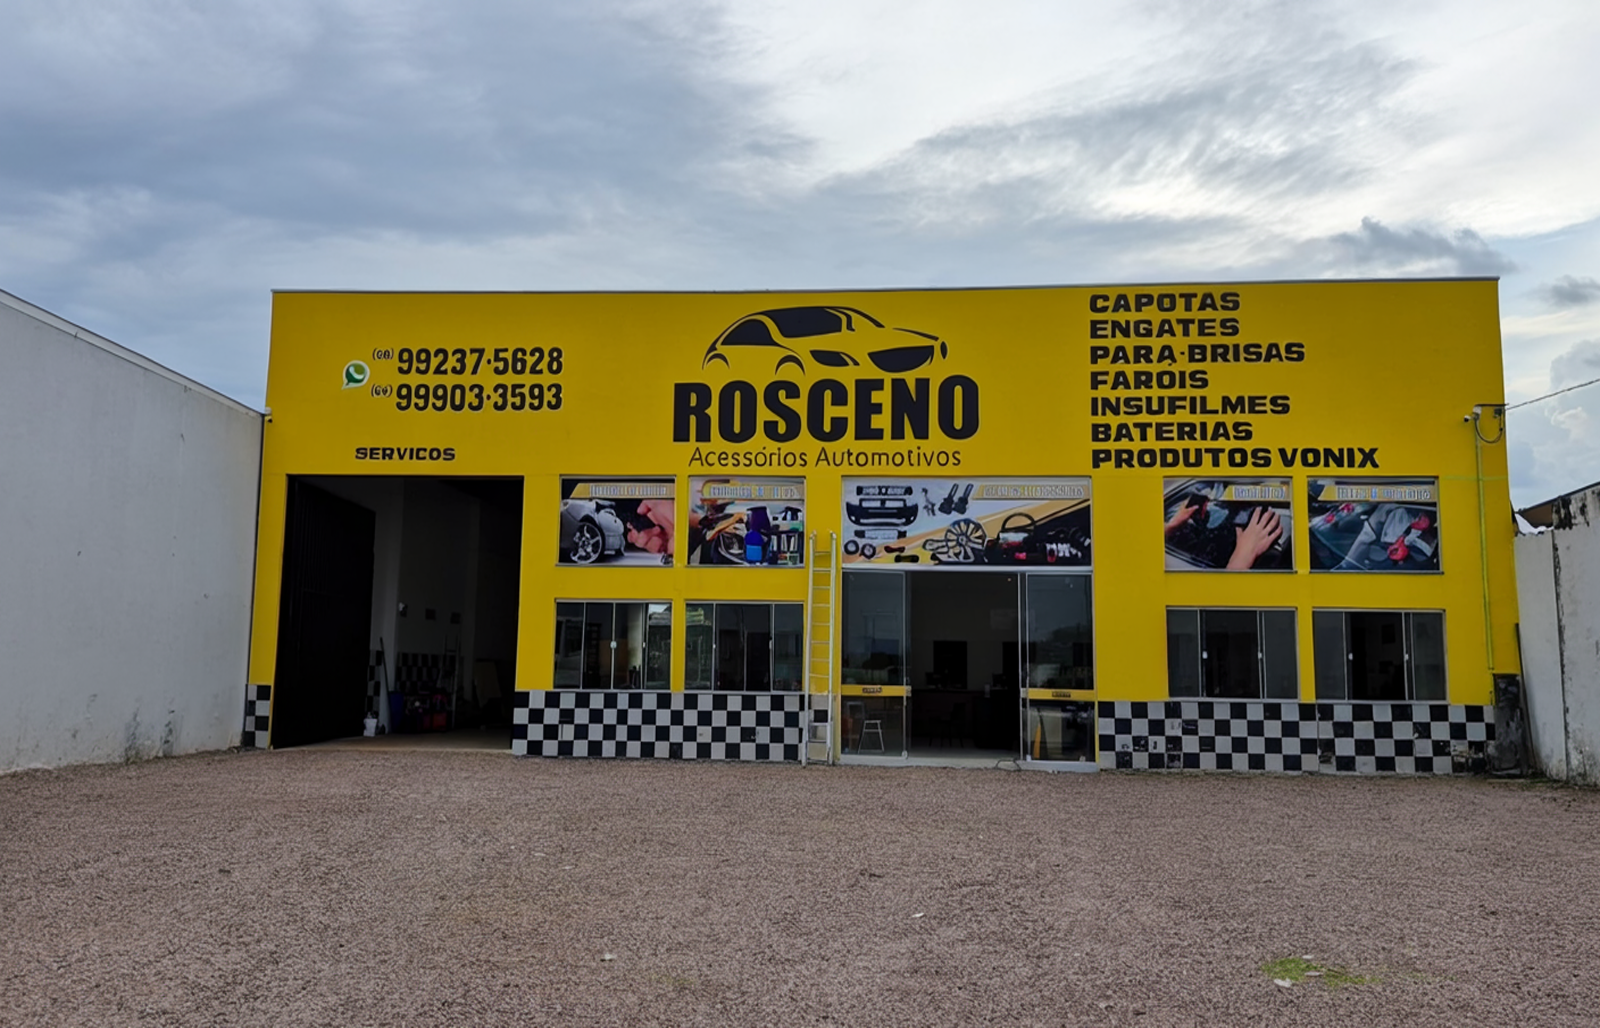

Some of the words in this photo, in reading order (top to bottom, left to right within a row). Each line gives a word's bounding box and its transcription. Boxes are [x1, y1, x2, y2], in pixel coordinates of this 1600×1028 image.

[1089, 291, 1241, 314] CAPOTAS
[1089, 317, 1240, 340] ENGATES
[672, 374, 980, 443] ROSCENO
[1090, 395, 1291, 417] INSUFILMES
[1091, 421, 1253, 443] BATERIAS
[355, 447, 456, 462] SERVICOS
[688, 446, 808, 468] Acessórios
[815, 446, 961, 467] Automotivos
[1091, 447, 1272, 469] PRODUTOS
[1277, 447, 1380, 469] VONIX
